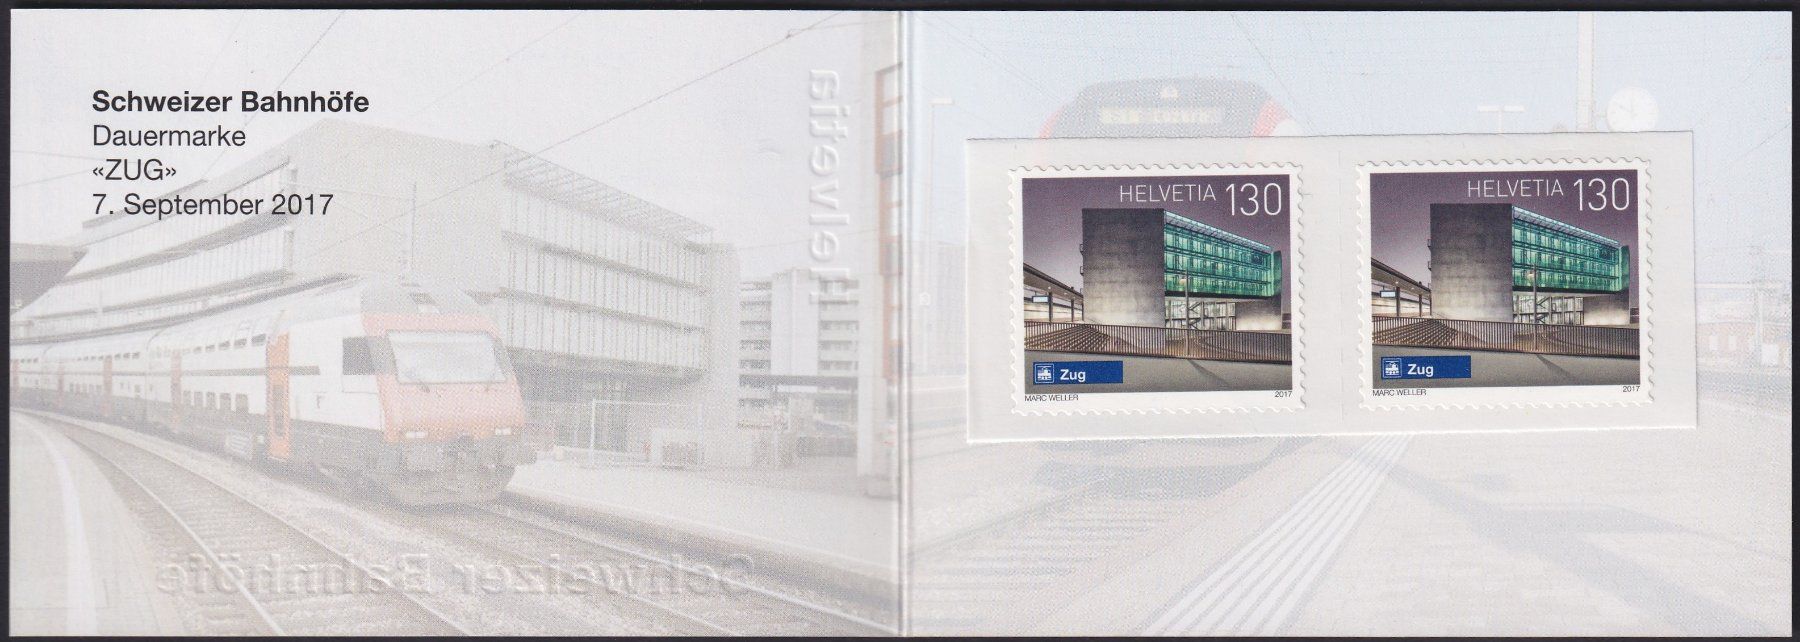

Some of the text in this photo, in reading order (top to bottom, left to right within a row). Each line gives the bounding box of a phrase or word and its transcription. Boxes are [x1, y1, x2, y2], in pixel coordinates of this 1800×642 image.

[92, 90, 370, 112] Schweizer Bahnhöfe
[93, 125, 246, 146] Dauermarke
[92, 158, 177, 181] «ZUG»
[1119, 182, 1283, 217] HELVETIA 130
[1467, 177, 1631, 212] HELVETIA 130
[92, 192, 334, 220] 7. September 2017
[1060, 368, 1086, 382] Zug
[1407, 363, 1434, 378] Zug
[1024, 394, 1047, 402] MARC
[1274, 390, 1293, 398] 2017
[1396, 388, 1427, 396] WELLER
[1622, 385, 1640, 393] 2017
